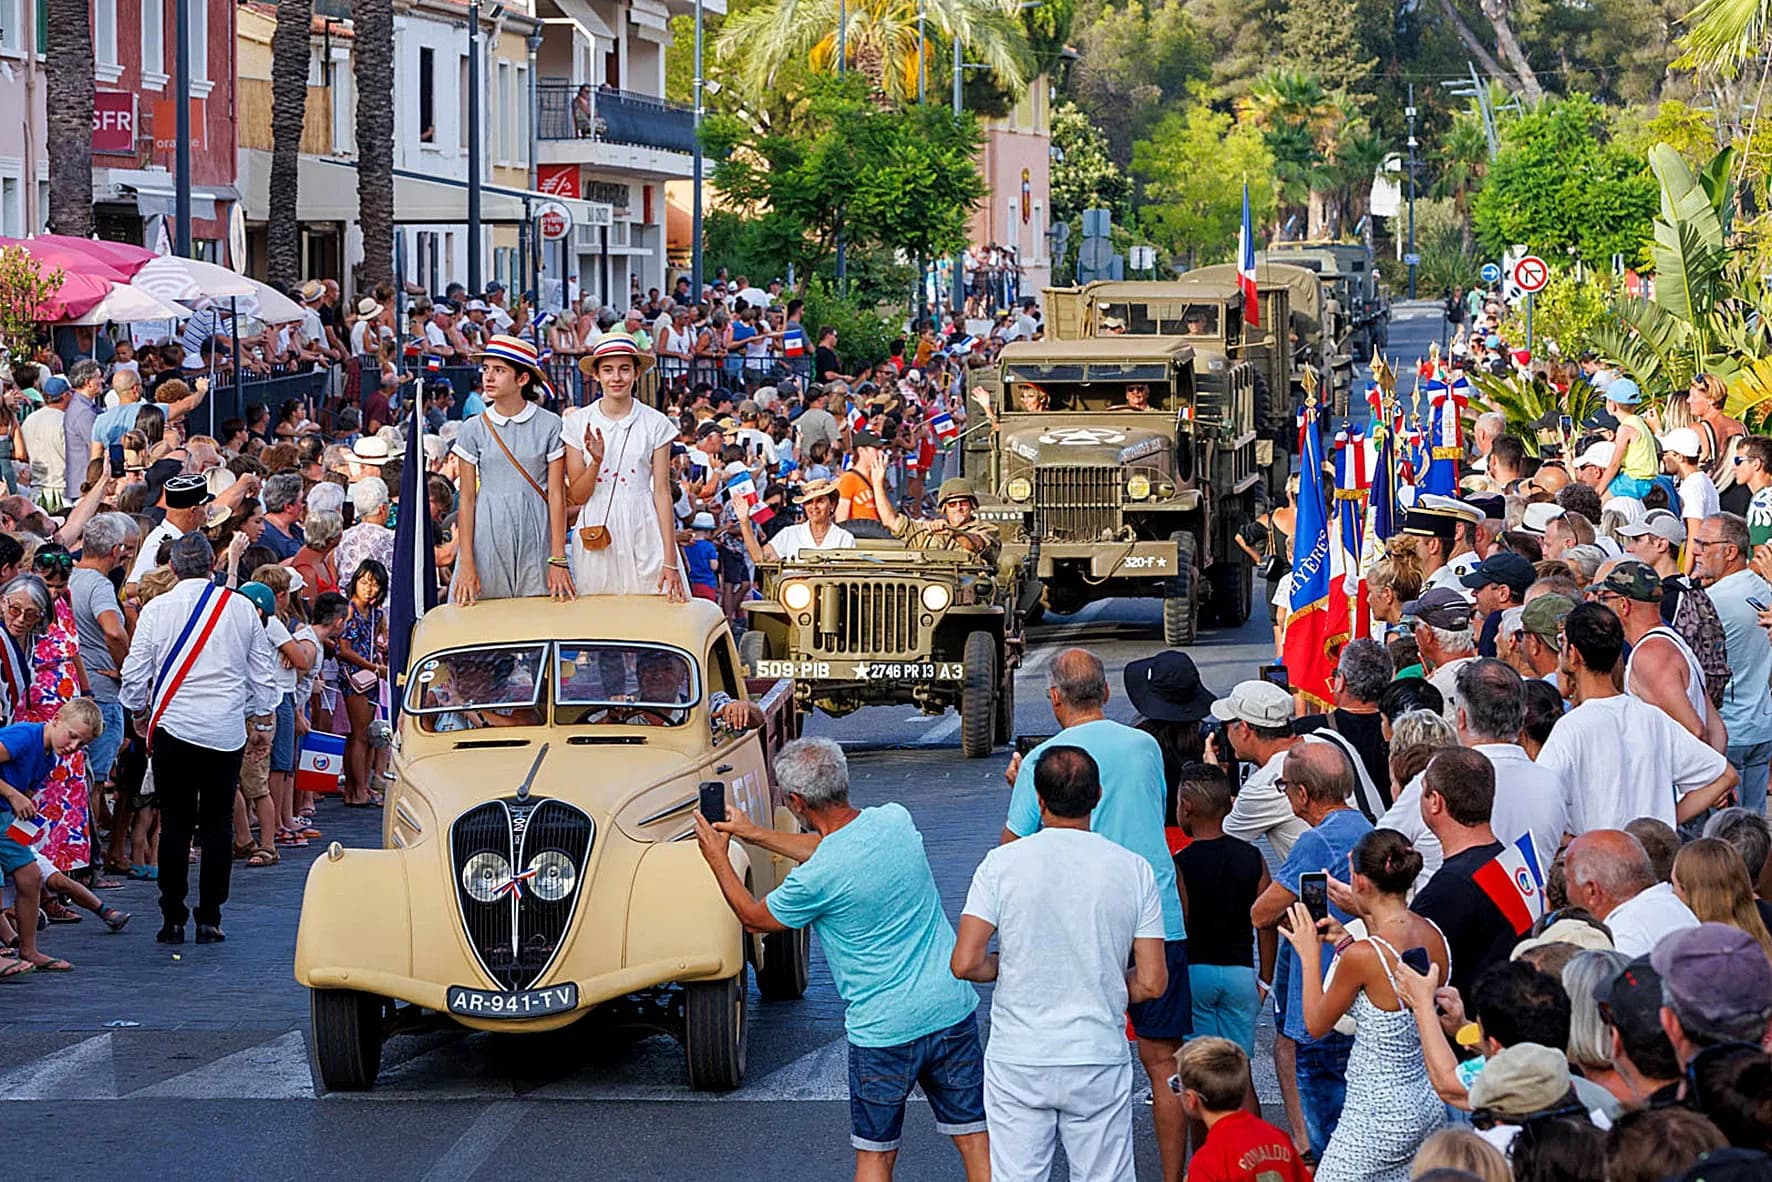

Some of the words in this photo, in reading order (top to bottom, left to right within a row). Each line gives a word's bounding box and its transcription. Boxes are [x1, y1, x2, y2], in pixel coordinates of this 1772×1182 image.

[93, 110, 131, 130] SFR
[156, 139, 200, 149] orae
[1124, 556, 1156, 568] 320-F
[871, 663, 901, 678] 2746
[904, 664, 920, 678] PR
[922, 664, 934, 678] 13
[1238, 1143, 1292, 1171] RONALDO
